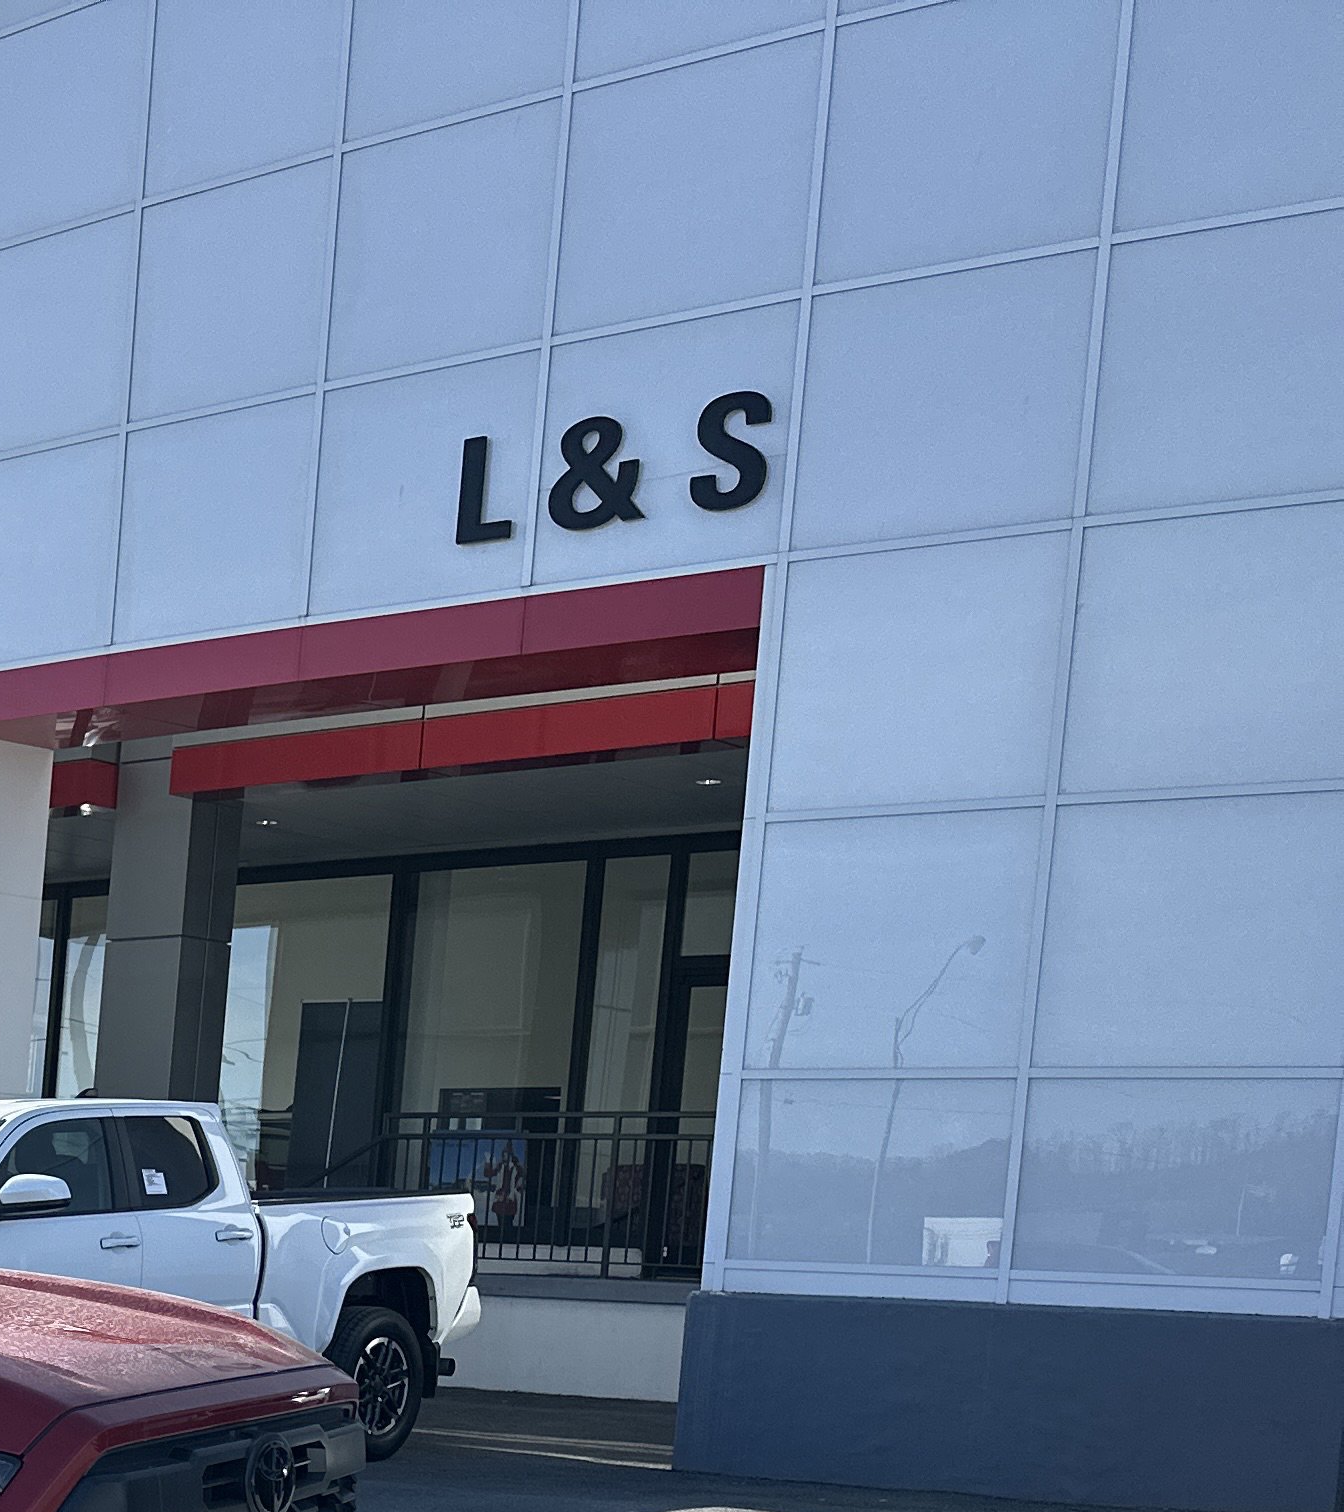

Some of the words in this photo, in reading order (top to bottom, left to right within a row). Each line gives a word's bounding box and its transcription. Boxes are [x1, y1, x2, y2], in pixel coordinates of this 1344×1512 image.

[456, 436, 512, 545] L
[548, 416, 646, 531] &
[689, 390, 772, 511] S
